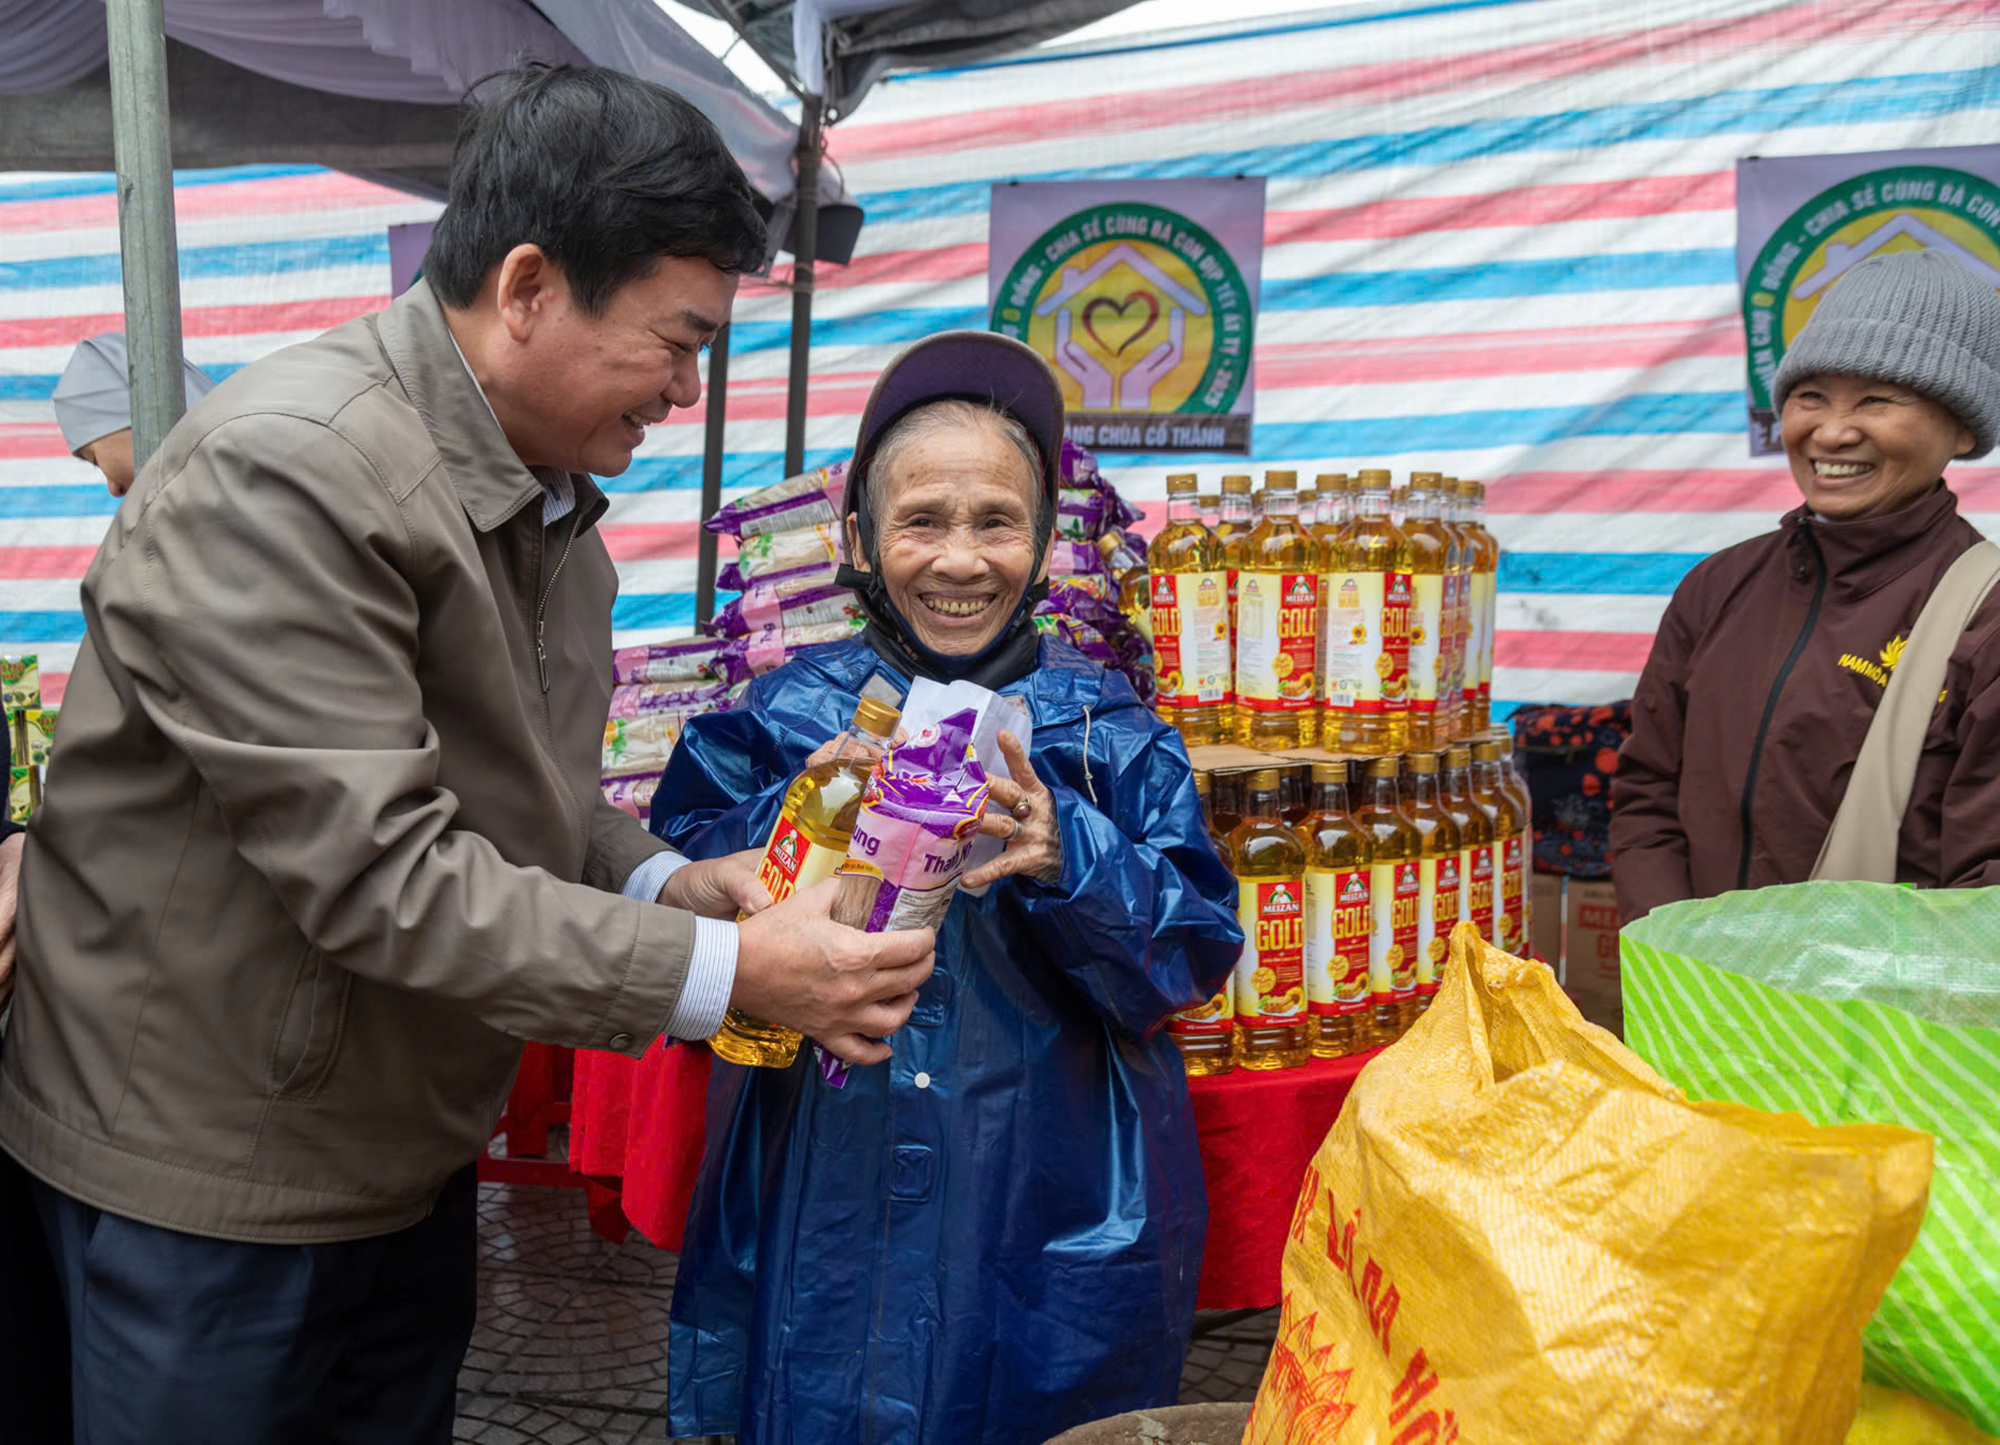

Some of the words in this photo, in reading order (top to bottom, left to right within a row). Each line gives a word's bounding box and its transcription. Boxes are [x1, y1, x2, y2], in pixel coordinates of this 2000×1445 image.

[1881, 177, 1937, 203] CÙNG
[1098, 421, 1141, 446] CHÙA
[1172, 422, 1226, 447] THÀNH
[773, 843, 798, 874] MEIZAN
[1263, 902, 1300, 913] MEIZAN
[1339, 891, 1369, 901] MEIZAN
[1255, 917, 1305, 951] GOLD
[1332, 905, 1371, 939] GOLD
